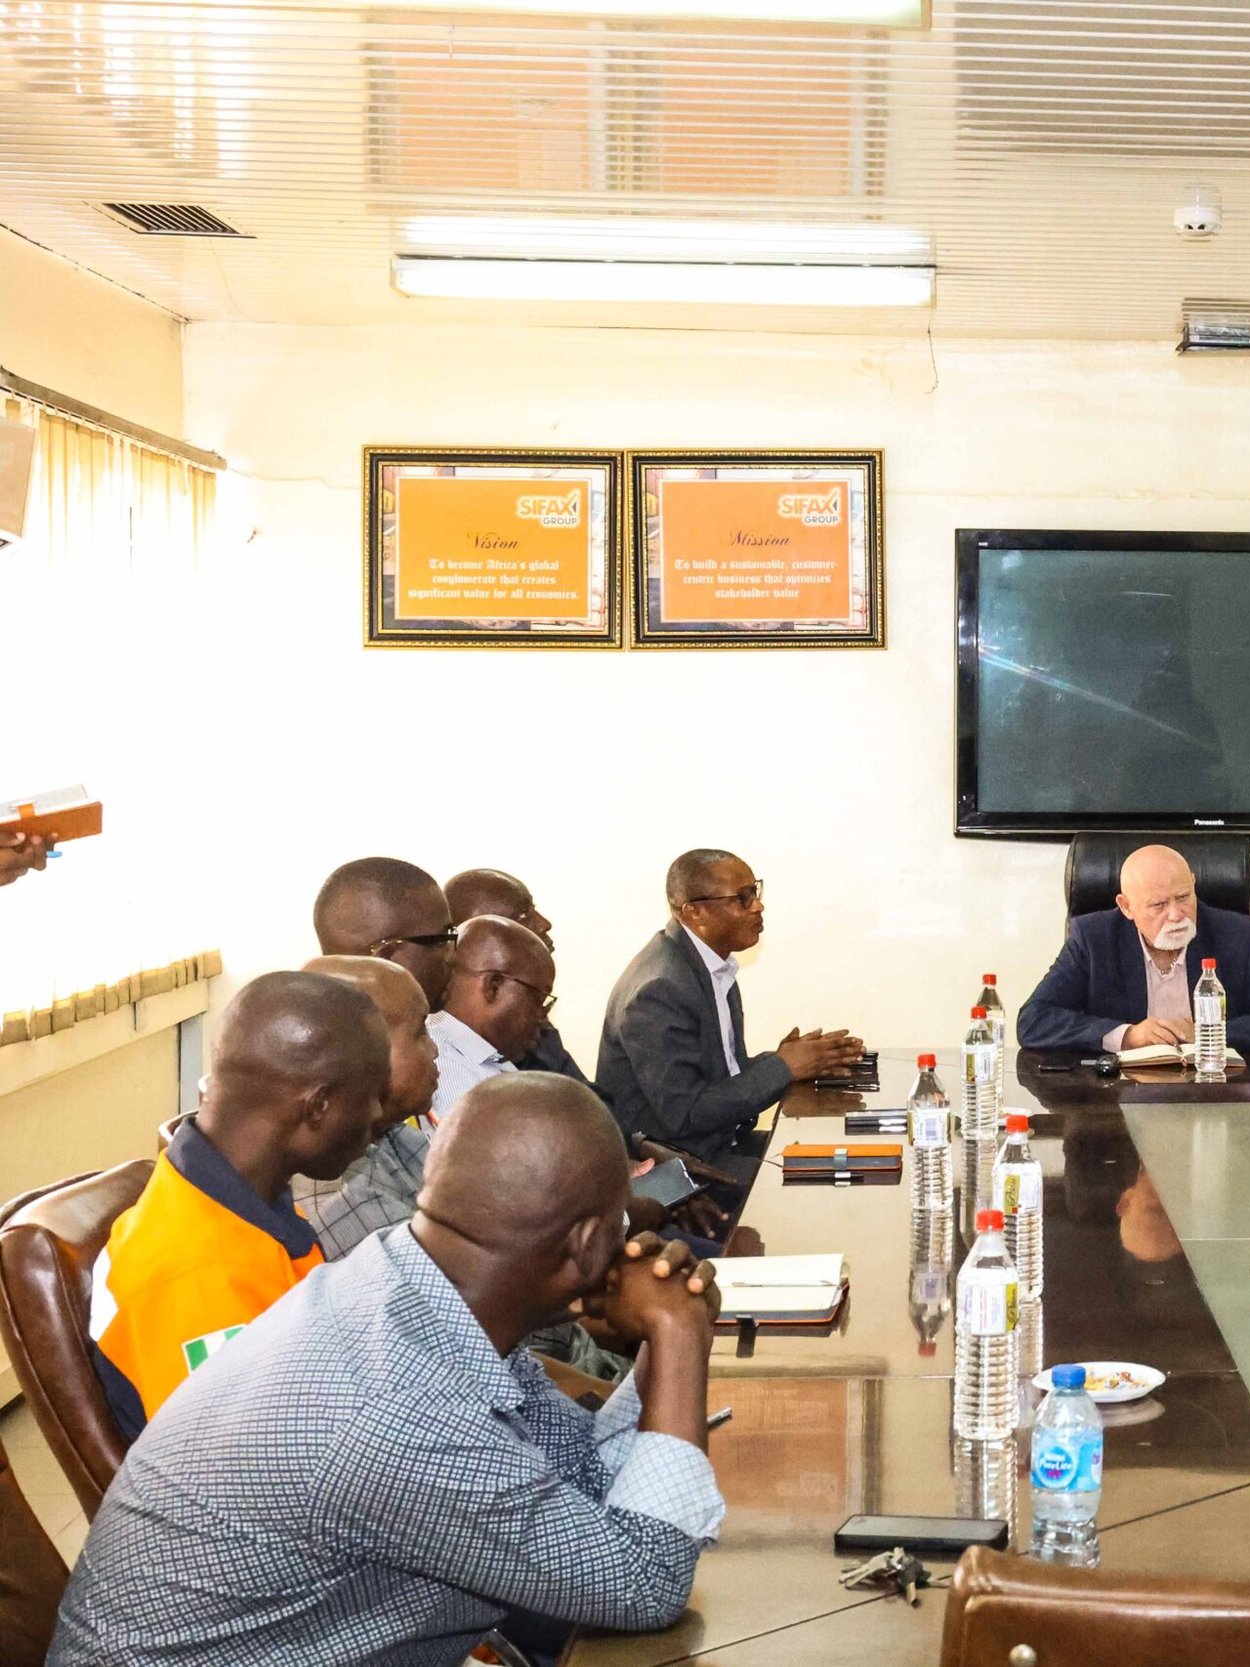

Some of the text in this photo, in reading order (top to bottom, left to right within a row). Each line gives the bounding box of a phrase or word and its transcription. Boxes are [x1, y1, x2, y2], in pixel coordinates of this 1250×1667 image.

[519, 491, 577, 516] SIFAX
[781, 490, 838, 514] SIFAX
[542, 516, 578, 525] GROUP
[804, 515, 838, 523] GROUP
[467, 532, 520, 550] Vision
[729, 530, 791, 546] Mission
[428, 559, 445, 570] To
[447, 560, 483, 570] become
[528, 560, 560, 572] global
[674, 559, 690, 570] To
[692, 559, 718, 570] build
[720, 562, 727, 570] a
[432, 574, 557, 585] conglomerate that creates
[683, 574, 715, 584] centric
[717, 574, 762, 584] business
[764, 574, 783, 584] that
[408, 588, 461, 600] significant
[463, 589, 490, 599] value
[493, 589, 507, 599] for
[510, 589, 523, 599] all
[714, 588, 799, 599] stakeholder value
